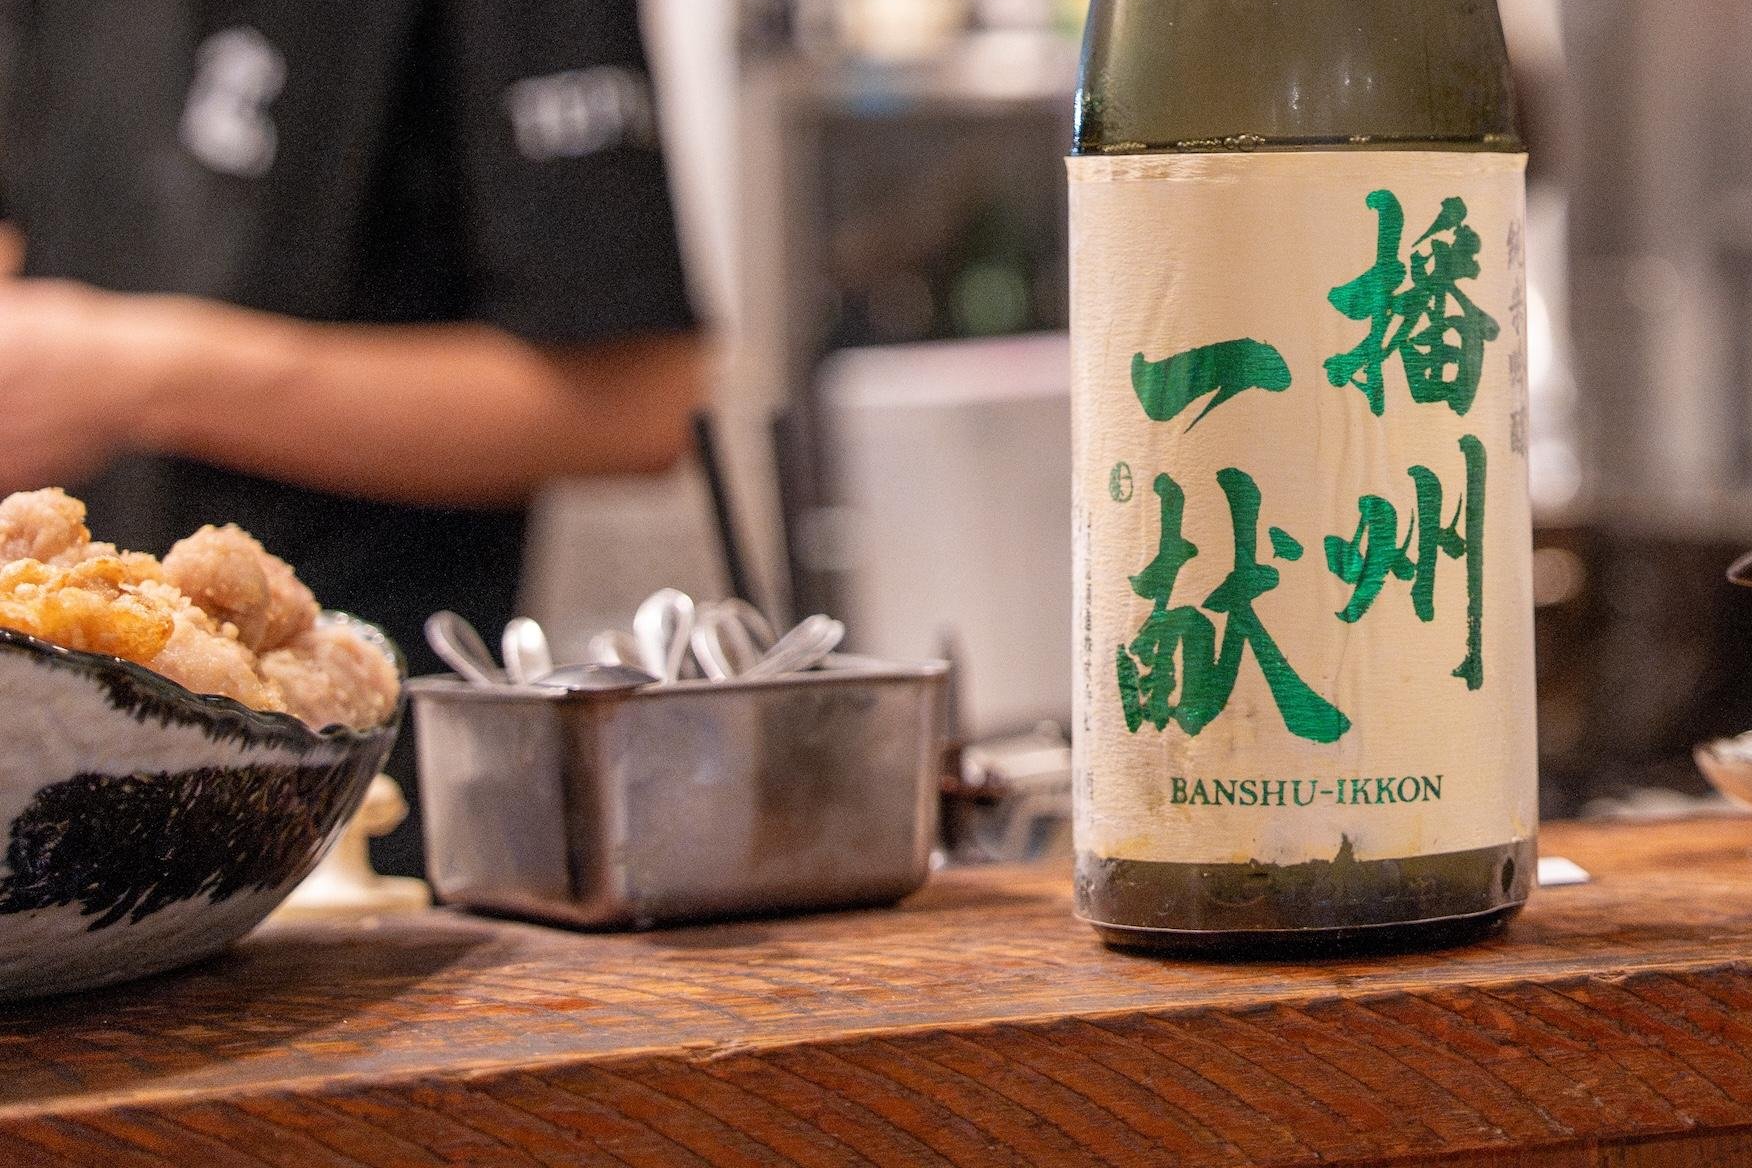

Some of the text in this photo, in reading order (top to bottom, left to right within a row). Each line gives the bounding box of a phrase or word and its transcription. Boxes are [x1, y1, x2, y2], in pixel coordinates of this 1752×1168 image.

[1120, 338, 1350, 744] 一献
[1324, 189, 1500, 692] 播州
[1169, 774, 1444, 806] BANSHU-IKKON
